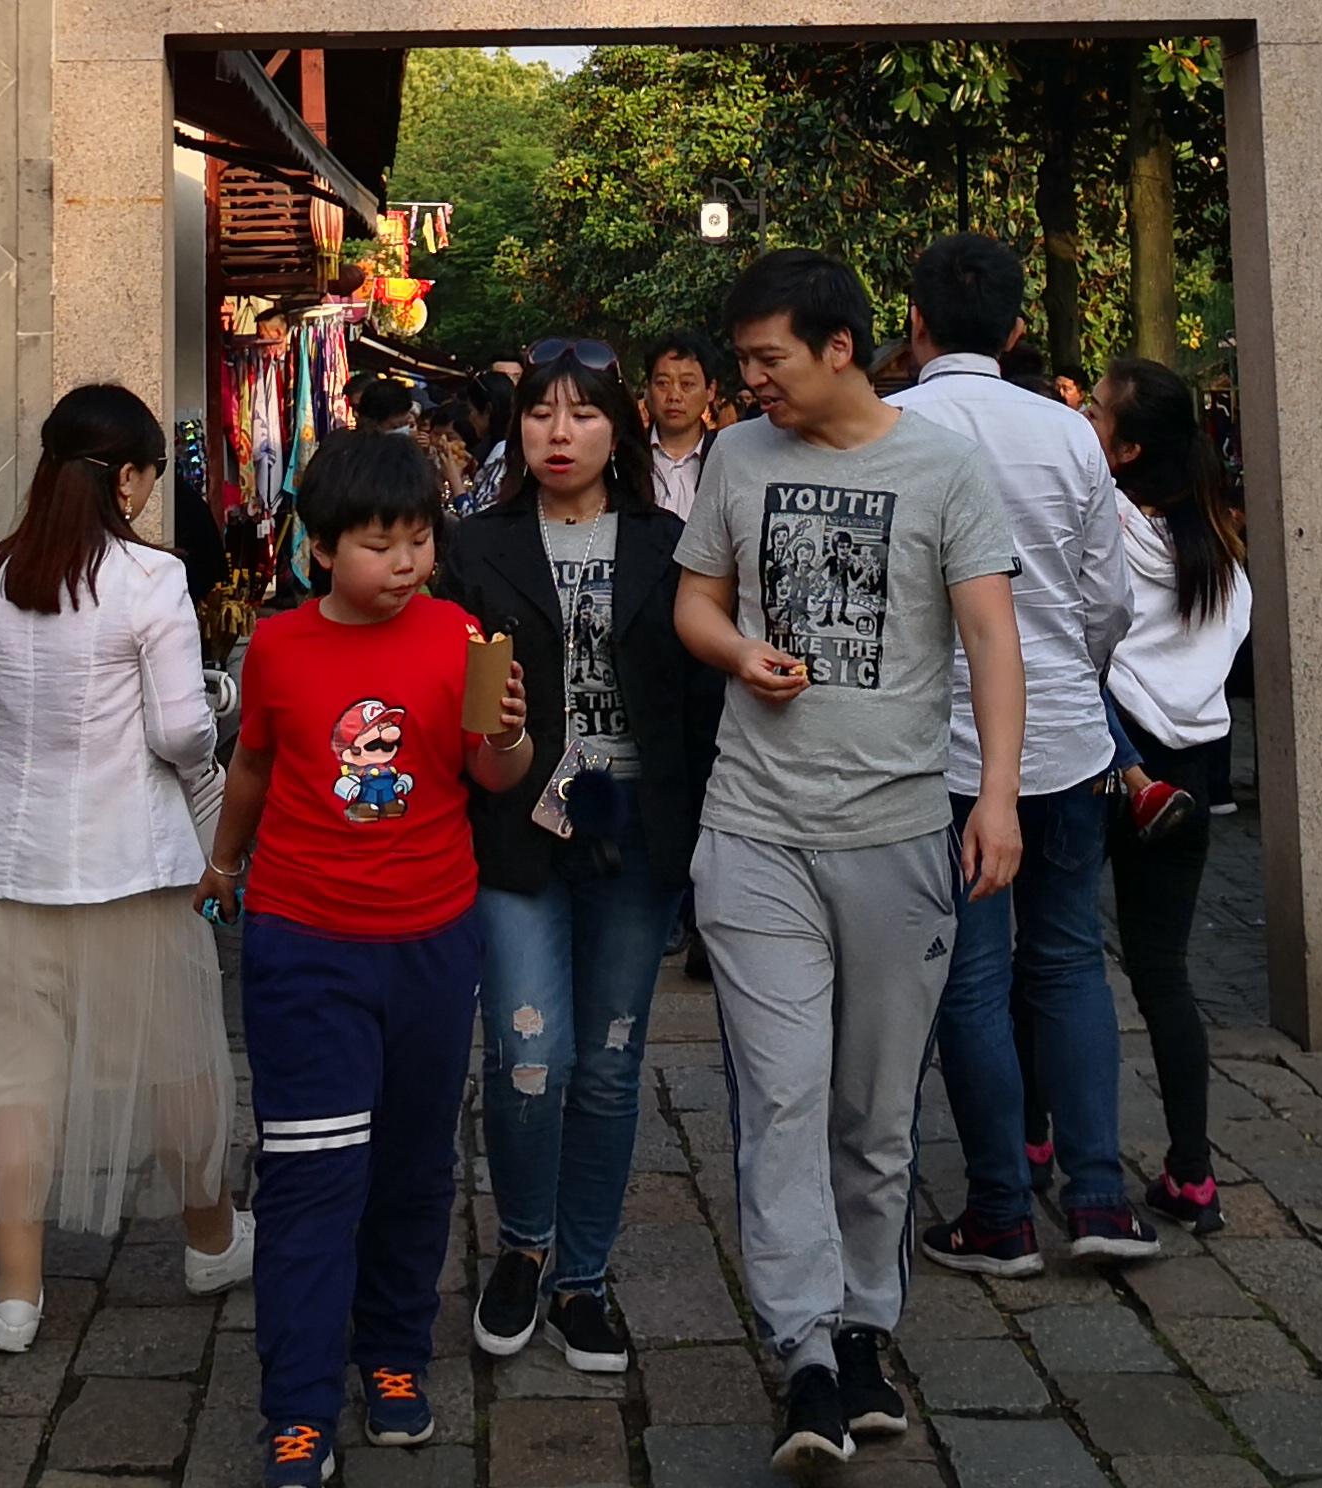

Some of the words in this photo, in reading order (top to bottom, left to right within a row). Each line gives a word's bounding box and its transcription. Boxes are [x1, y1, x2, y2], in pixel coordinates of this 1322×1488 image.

[778, 487, 887, 517] YOUTH
[778, 635, 823, 655] LIKE
[832, 639, 879, 659] THE
